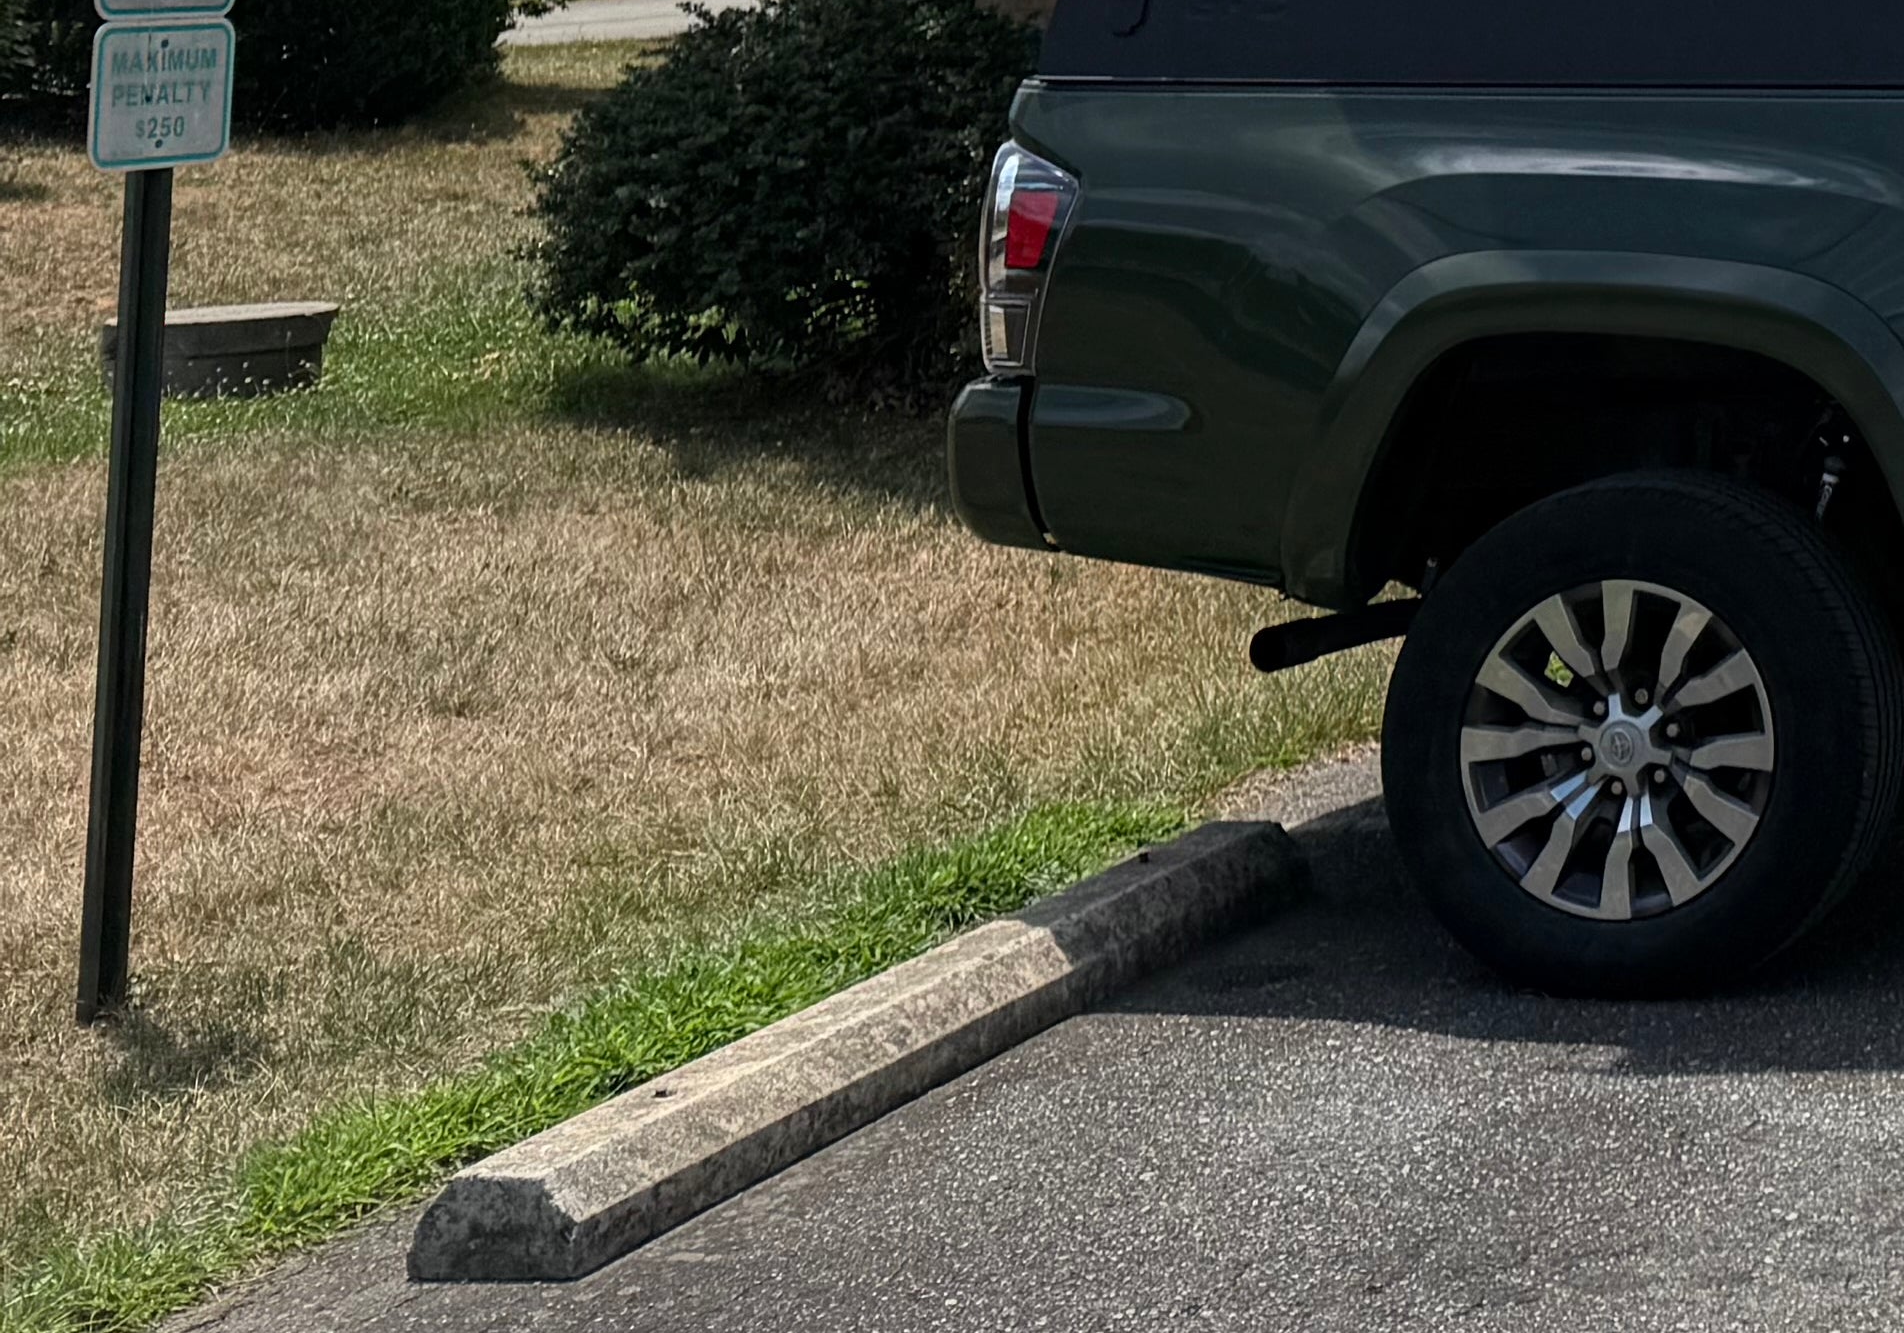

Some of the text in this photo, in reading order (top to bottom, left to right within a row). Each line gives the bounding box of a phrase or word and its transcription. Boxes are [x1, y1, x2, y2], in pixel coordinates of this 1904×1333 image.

[110, 47, 218, 74] MAXIMUM
[111, 79, 212, 108] PENALTY
[134, 115, 186, 140] $250
